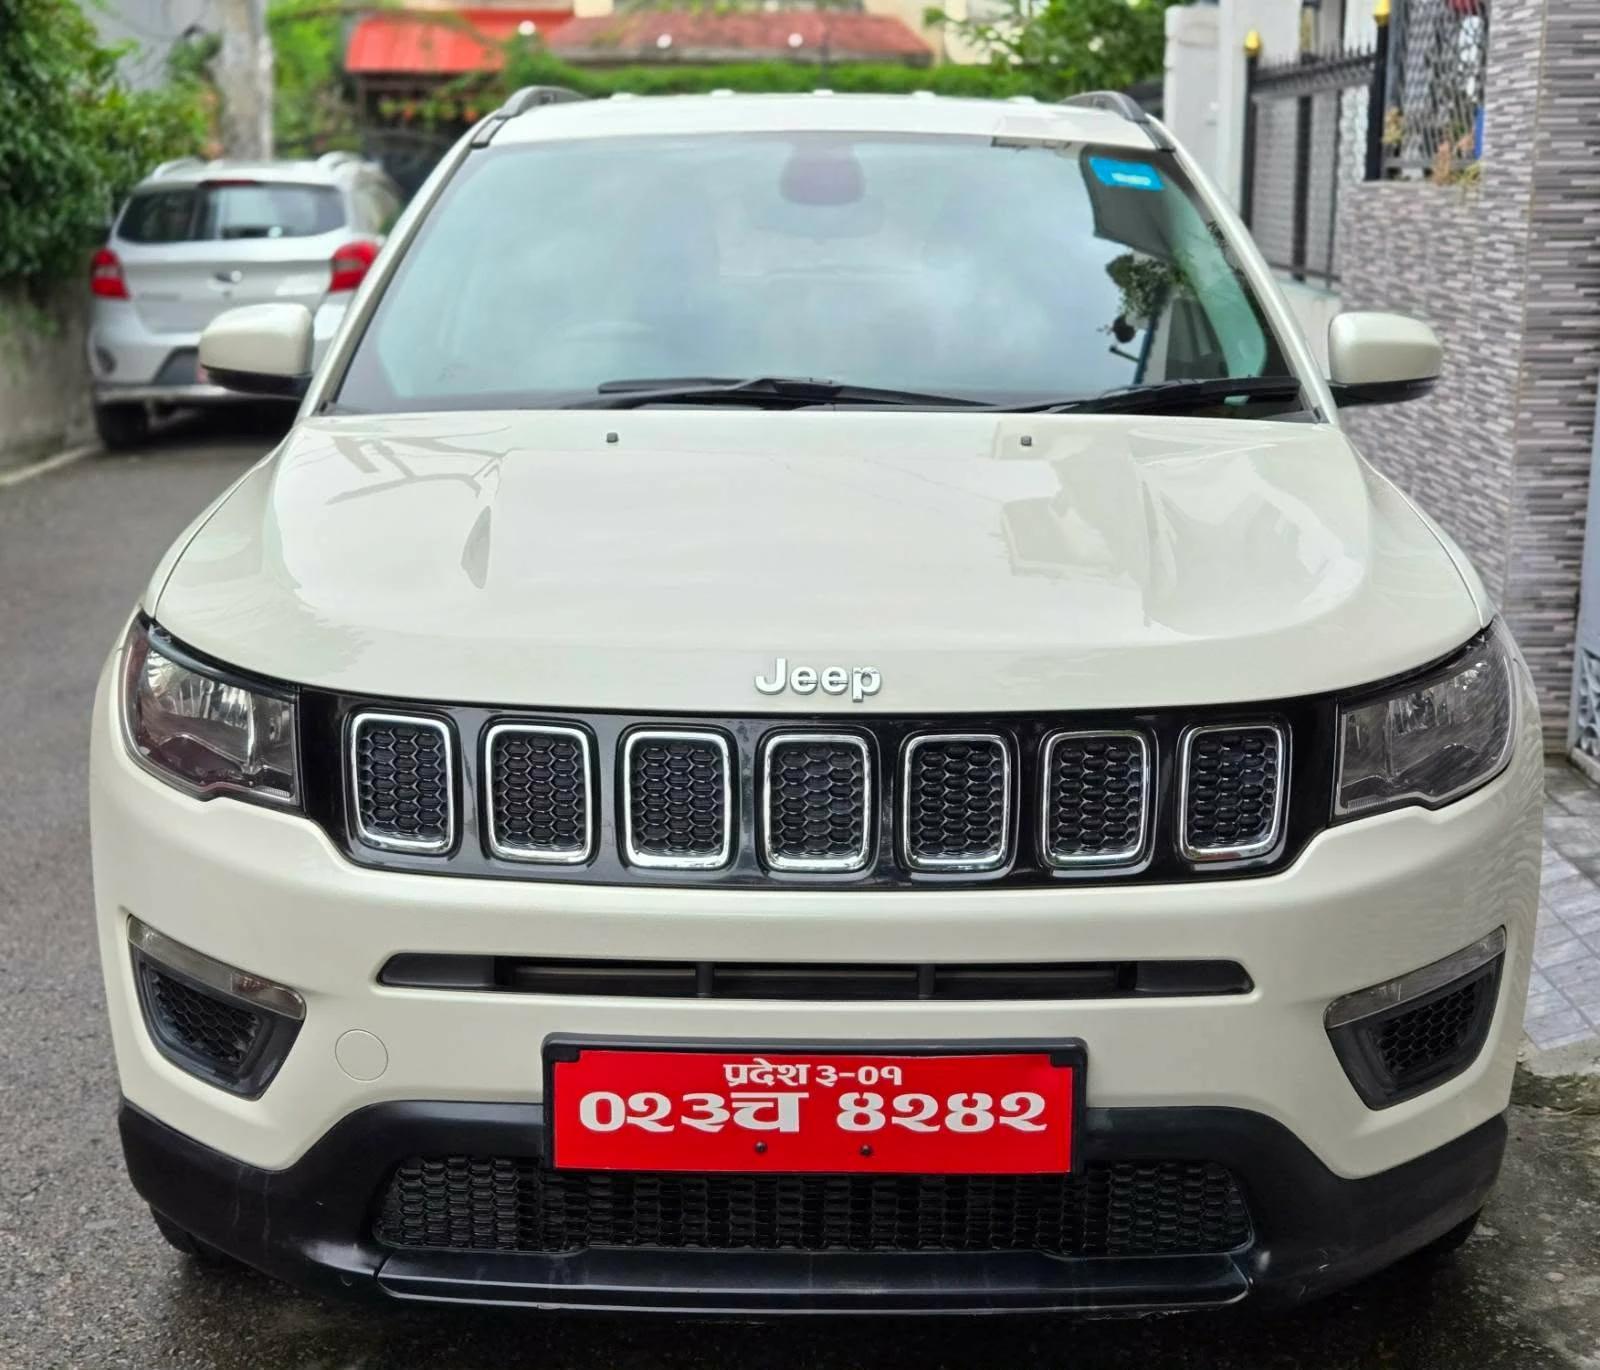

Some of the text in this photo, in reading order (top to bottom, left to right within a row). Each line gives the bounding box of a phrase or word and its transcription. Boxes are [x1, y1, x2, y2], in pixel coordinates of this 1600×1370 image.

[754, 657, 881, 702] Jeep
[723, 1057, 902, 1087] प्रदेश ३-०१
[579, 1091, 1047, 1133] ०२३च ४२४२
